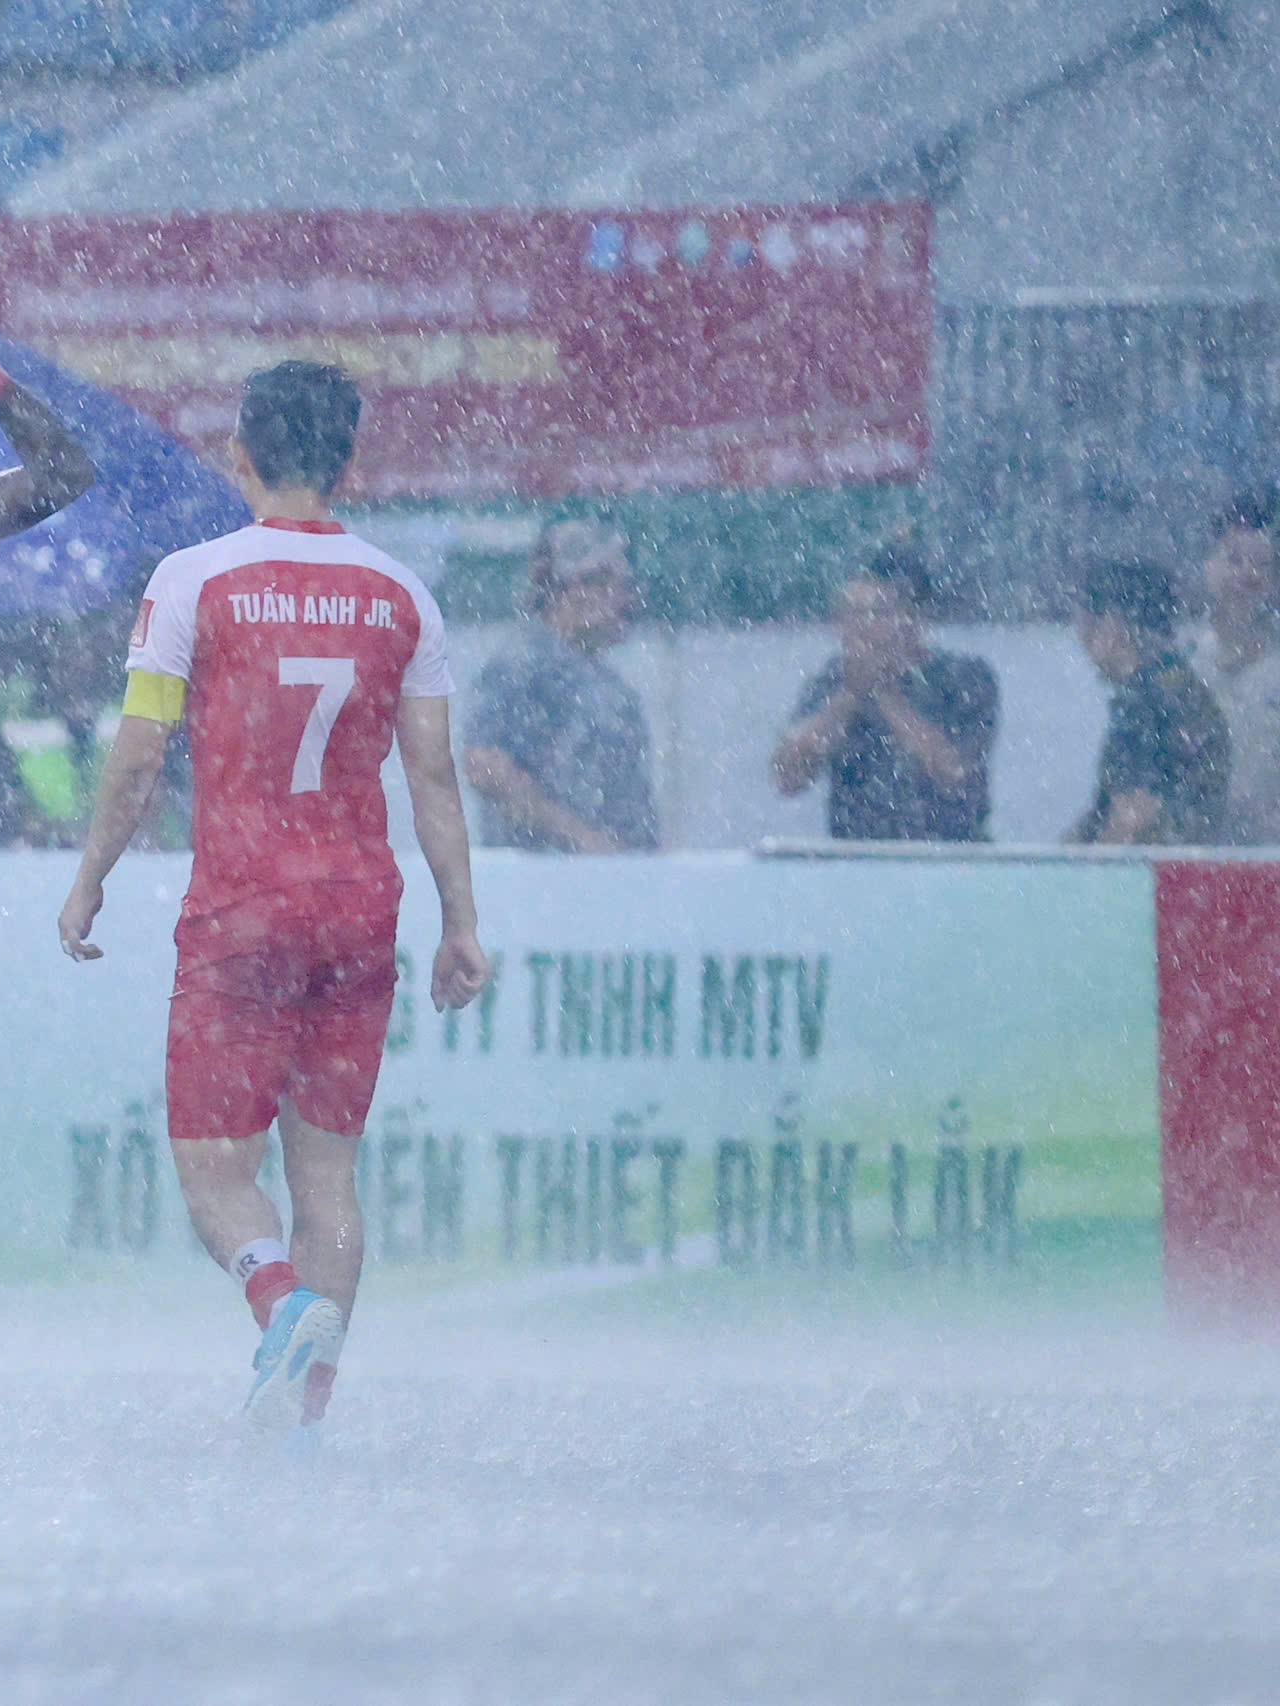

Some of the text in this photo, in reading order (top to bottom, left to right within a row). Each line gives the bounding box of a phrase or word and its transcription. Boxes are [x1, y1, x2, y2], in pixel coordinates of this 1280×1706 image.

[228, 582, 397, 630] TUẤN ANH JR.
[278, 656, 355, 795] 7
[699, 953, 830, 1062] MTV
[356, 1096, 467, 1266] IẾN
